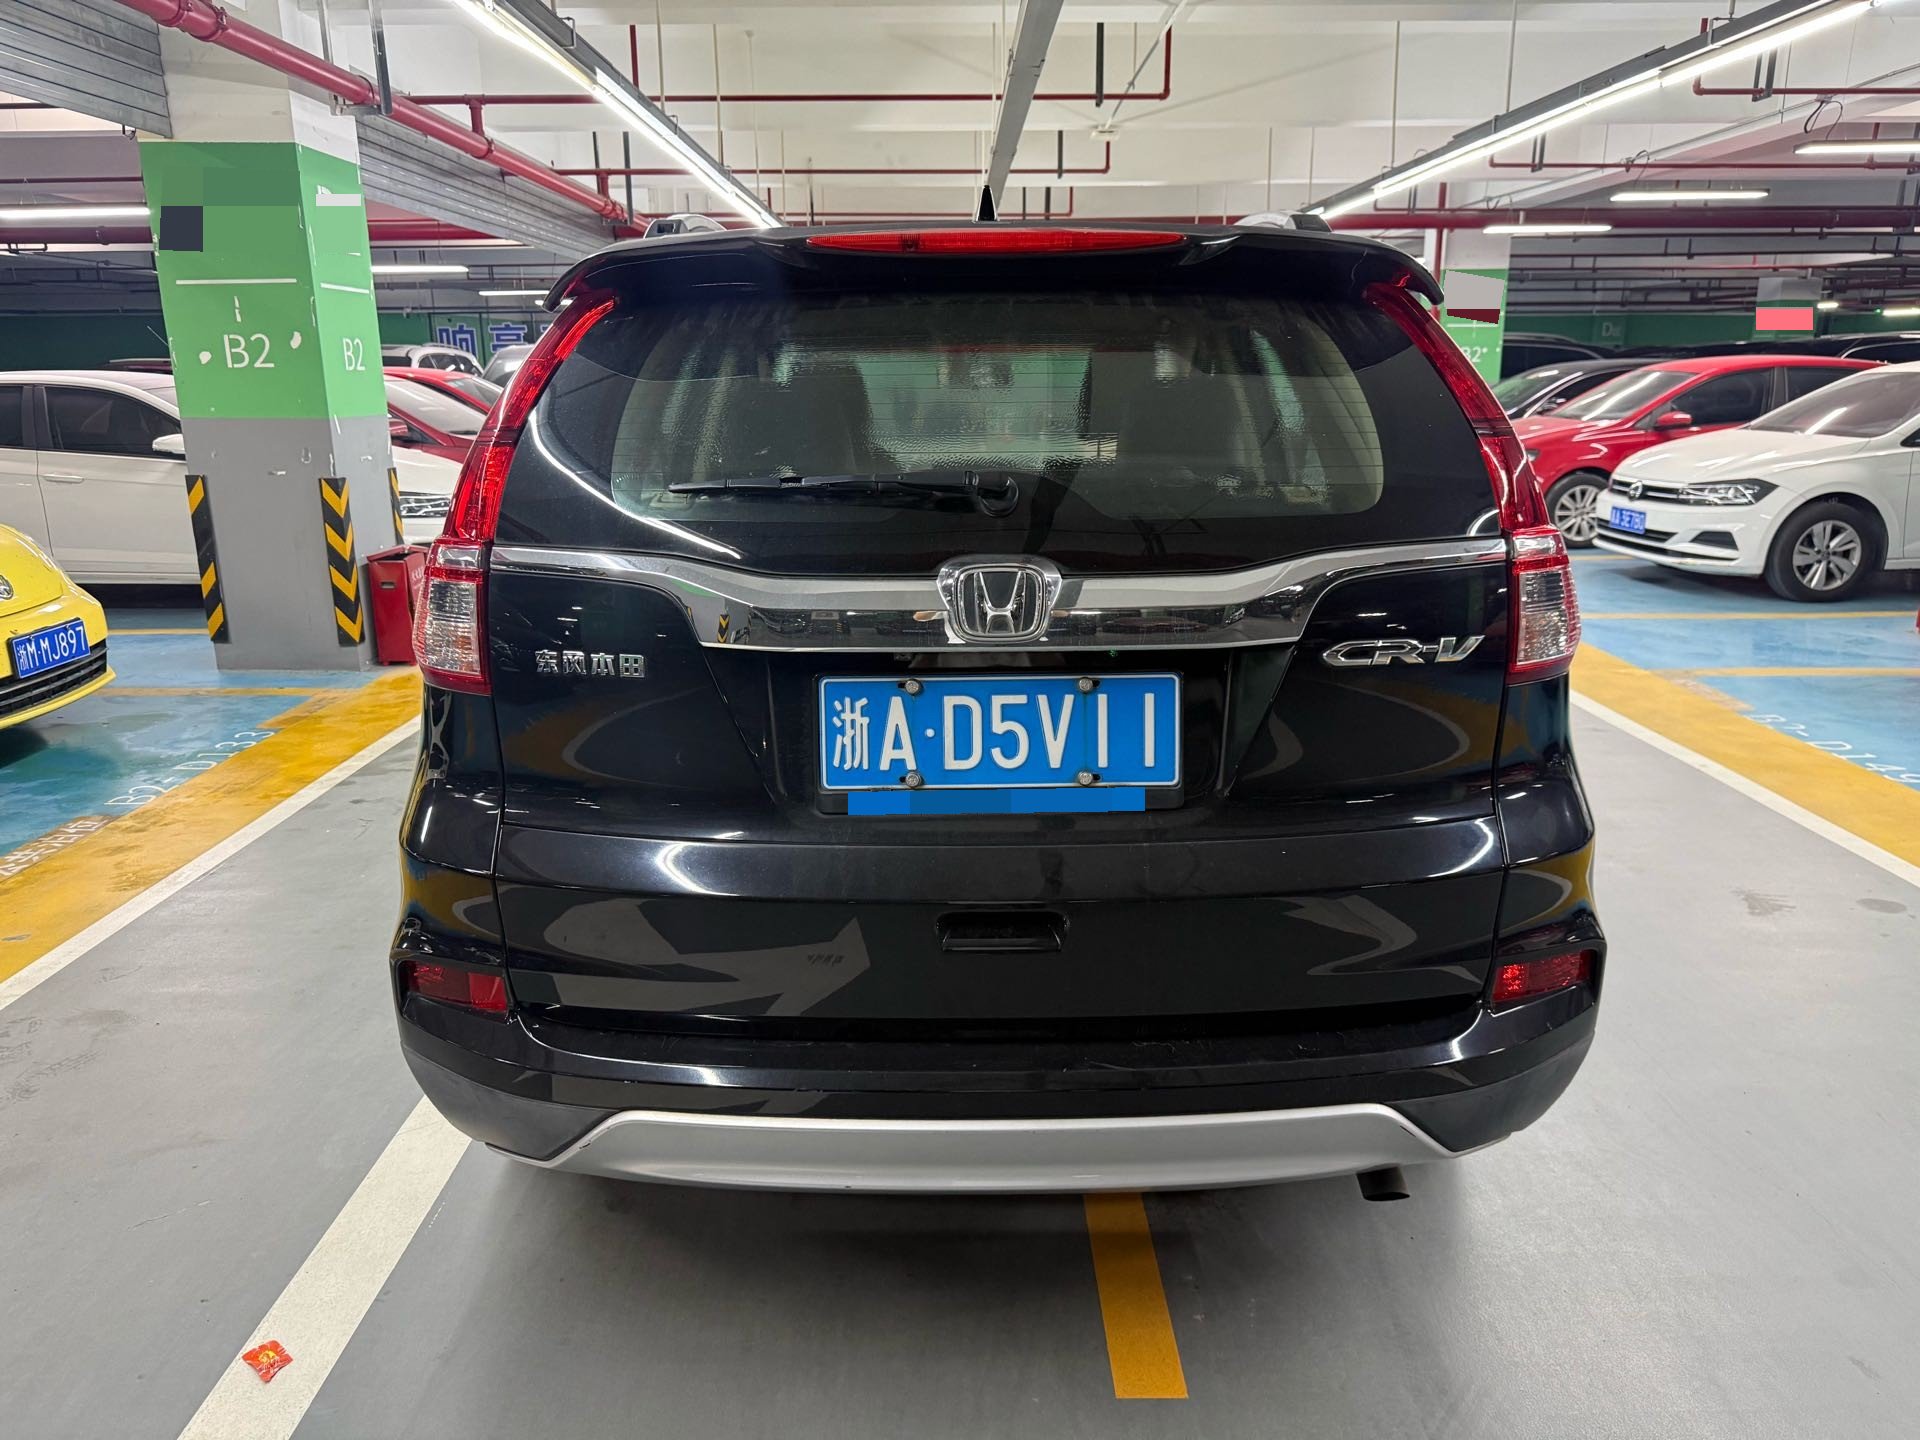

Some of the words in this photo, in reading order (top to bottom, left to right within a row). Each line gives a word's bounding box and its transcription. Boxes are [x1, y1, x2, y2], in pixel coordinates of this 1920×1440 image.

[223, 333, 275, 368] B2
[342, 337, 366, 371] B2
[535, 649, 645, 678] 东风本田
[1322, 634, 1487, 667] CR-V
[832, 692, 1156, 771] 浙A·D5V11
